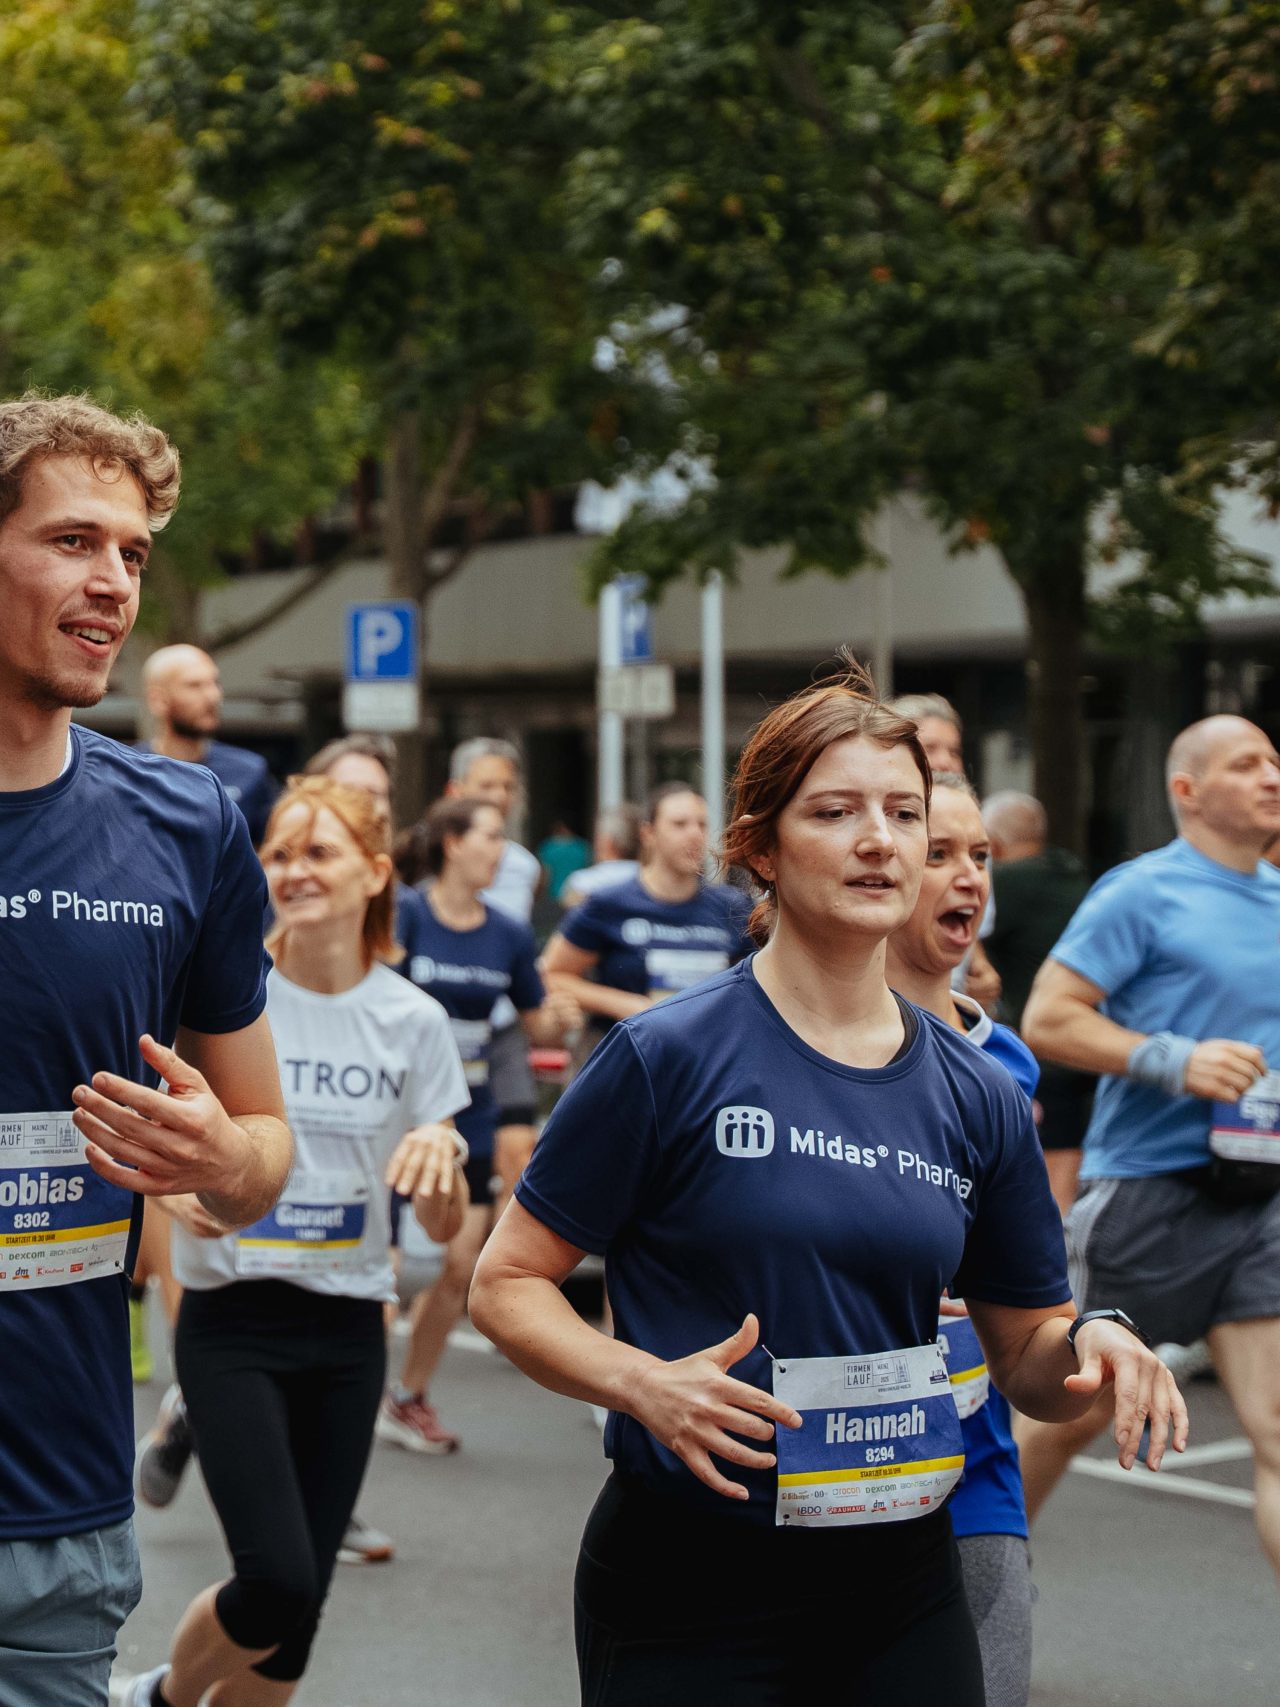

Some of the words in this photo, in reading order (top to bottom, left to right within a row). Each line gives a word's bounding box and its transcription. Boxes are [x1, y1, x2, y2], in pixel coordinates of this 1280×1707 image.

[358, 608, 404, 675] P
[51, 890, 164, 928] Pharma
[285, 1058, 407, 1100] TRON
[31, 1123, 49, 1132] MAINZ
[13, 1211, 50, 1229] 8302
[15, 1267, 29, 1276] dm
[847, 1364, 871, 1374] FIRMEN
[847, 1373, 871, 1386] LAUF
[825, 1404, 926, 1444] Hannah
[865, 1445, 895, 1463] 8294
[800, 1505, 822, 1515] BDO
[873, 1499, 885, 1508] dm
